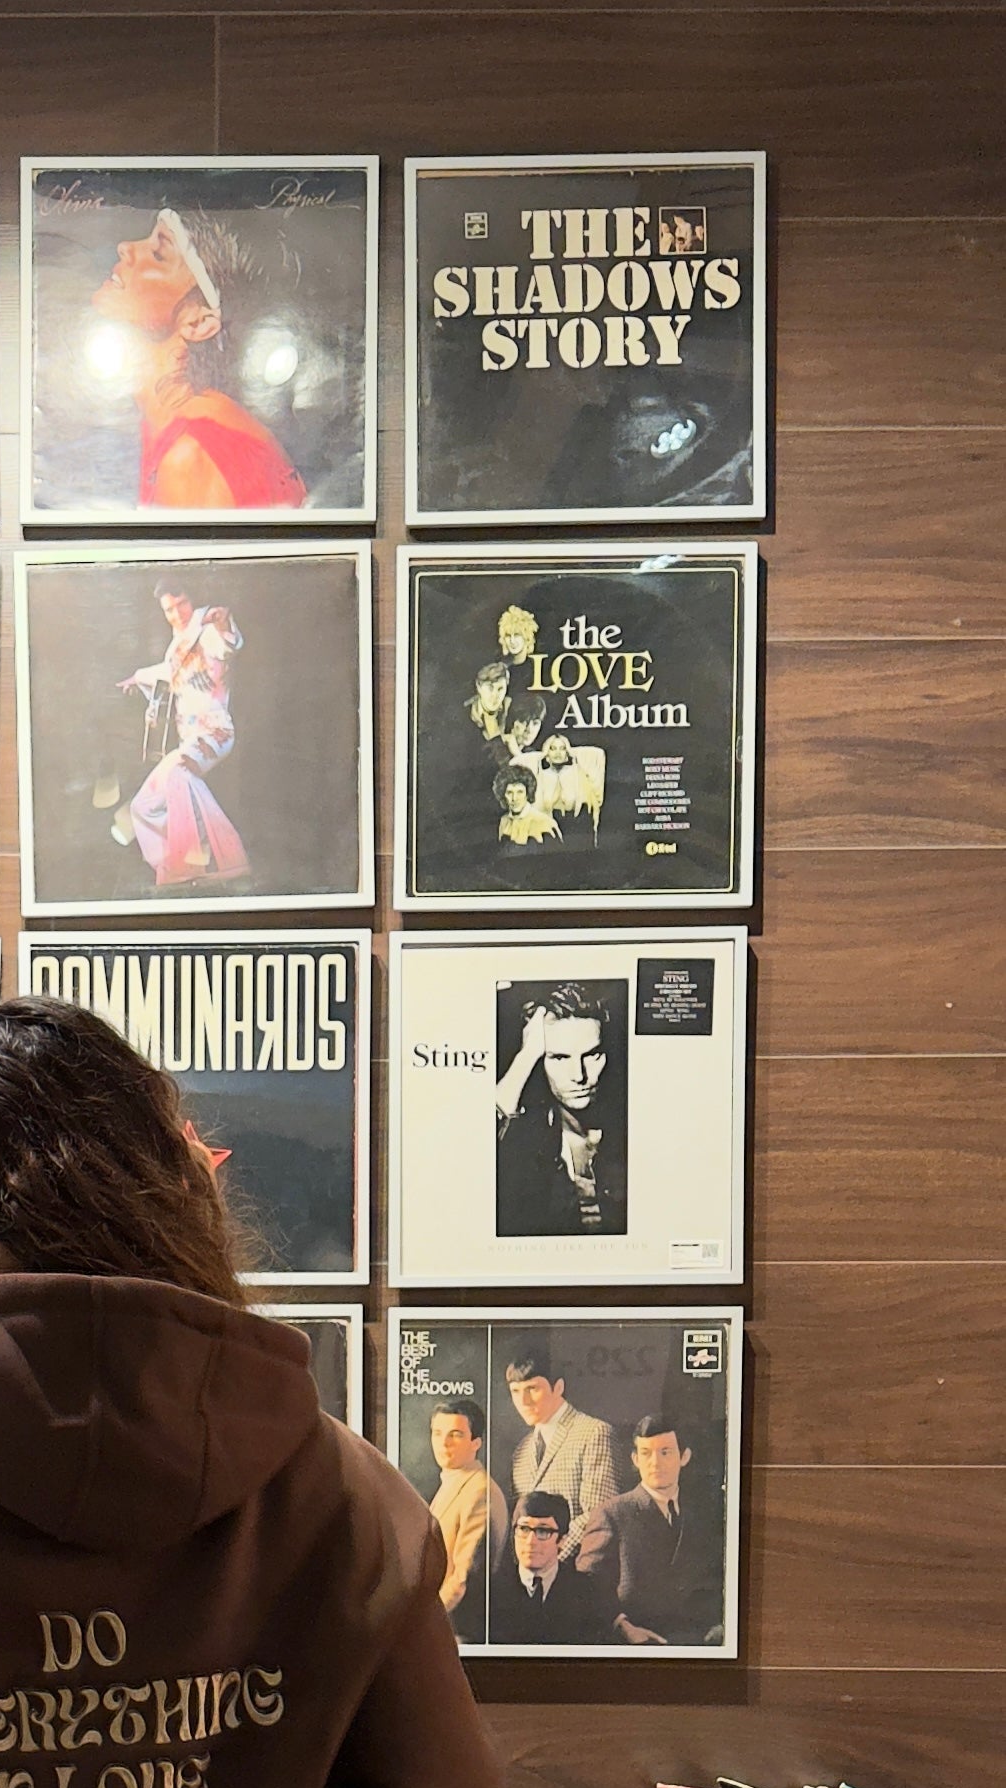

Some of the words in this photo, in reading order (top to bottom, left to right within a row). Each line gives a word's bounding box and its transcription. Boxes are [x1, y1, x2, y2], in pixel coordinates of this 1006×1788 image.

[521, 206, 651, 260] THE
[433, 258, 742, 319] SHADOWS
[482, 315, 692, 371] STORY
[559, 614, 623, 650] the
[527, 650, 655, 693] LOVE
[555, 693, 691, 728] Album
[412, 1042, 489, 1073] Sting
[401, 1331, 430, 1344] THE
[401, 1344, 437, 1357] BEST
[401, 1356, 422, 1369] OF
[401, 1369, 430, 1382] THE
[400, 1381, 474, 1396] SHADOWS
[38, 1608, 127, 1673] DO
